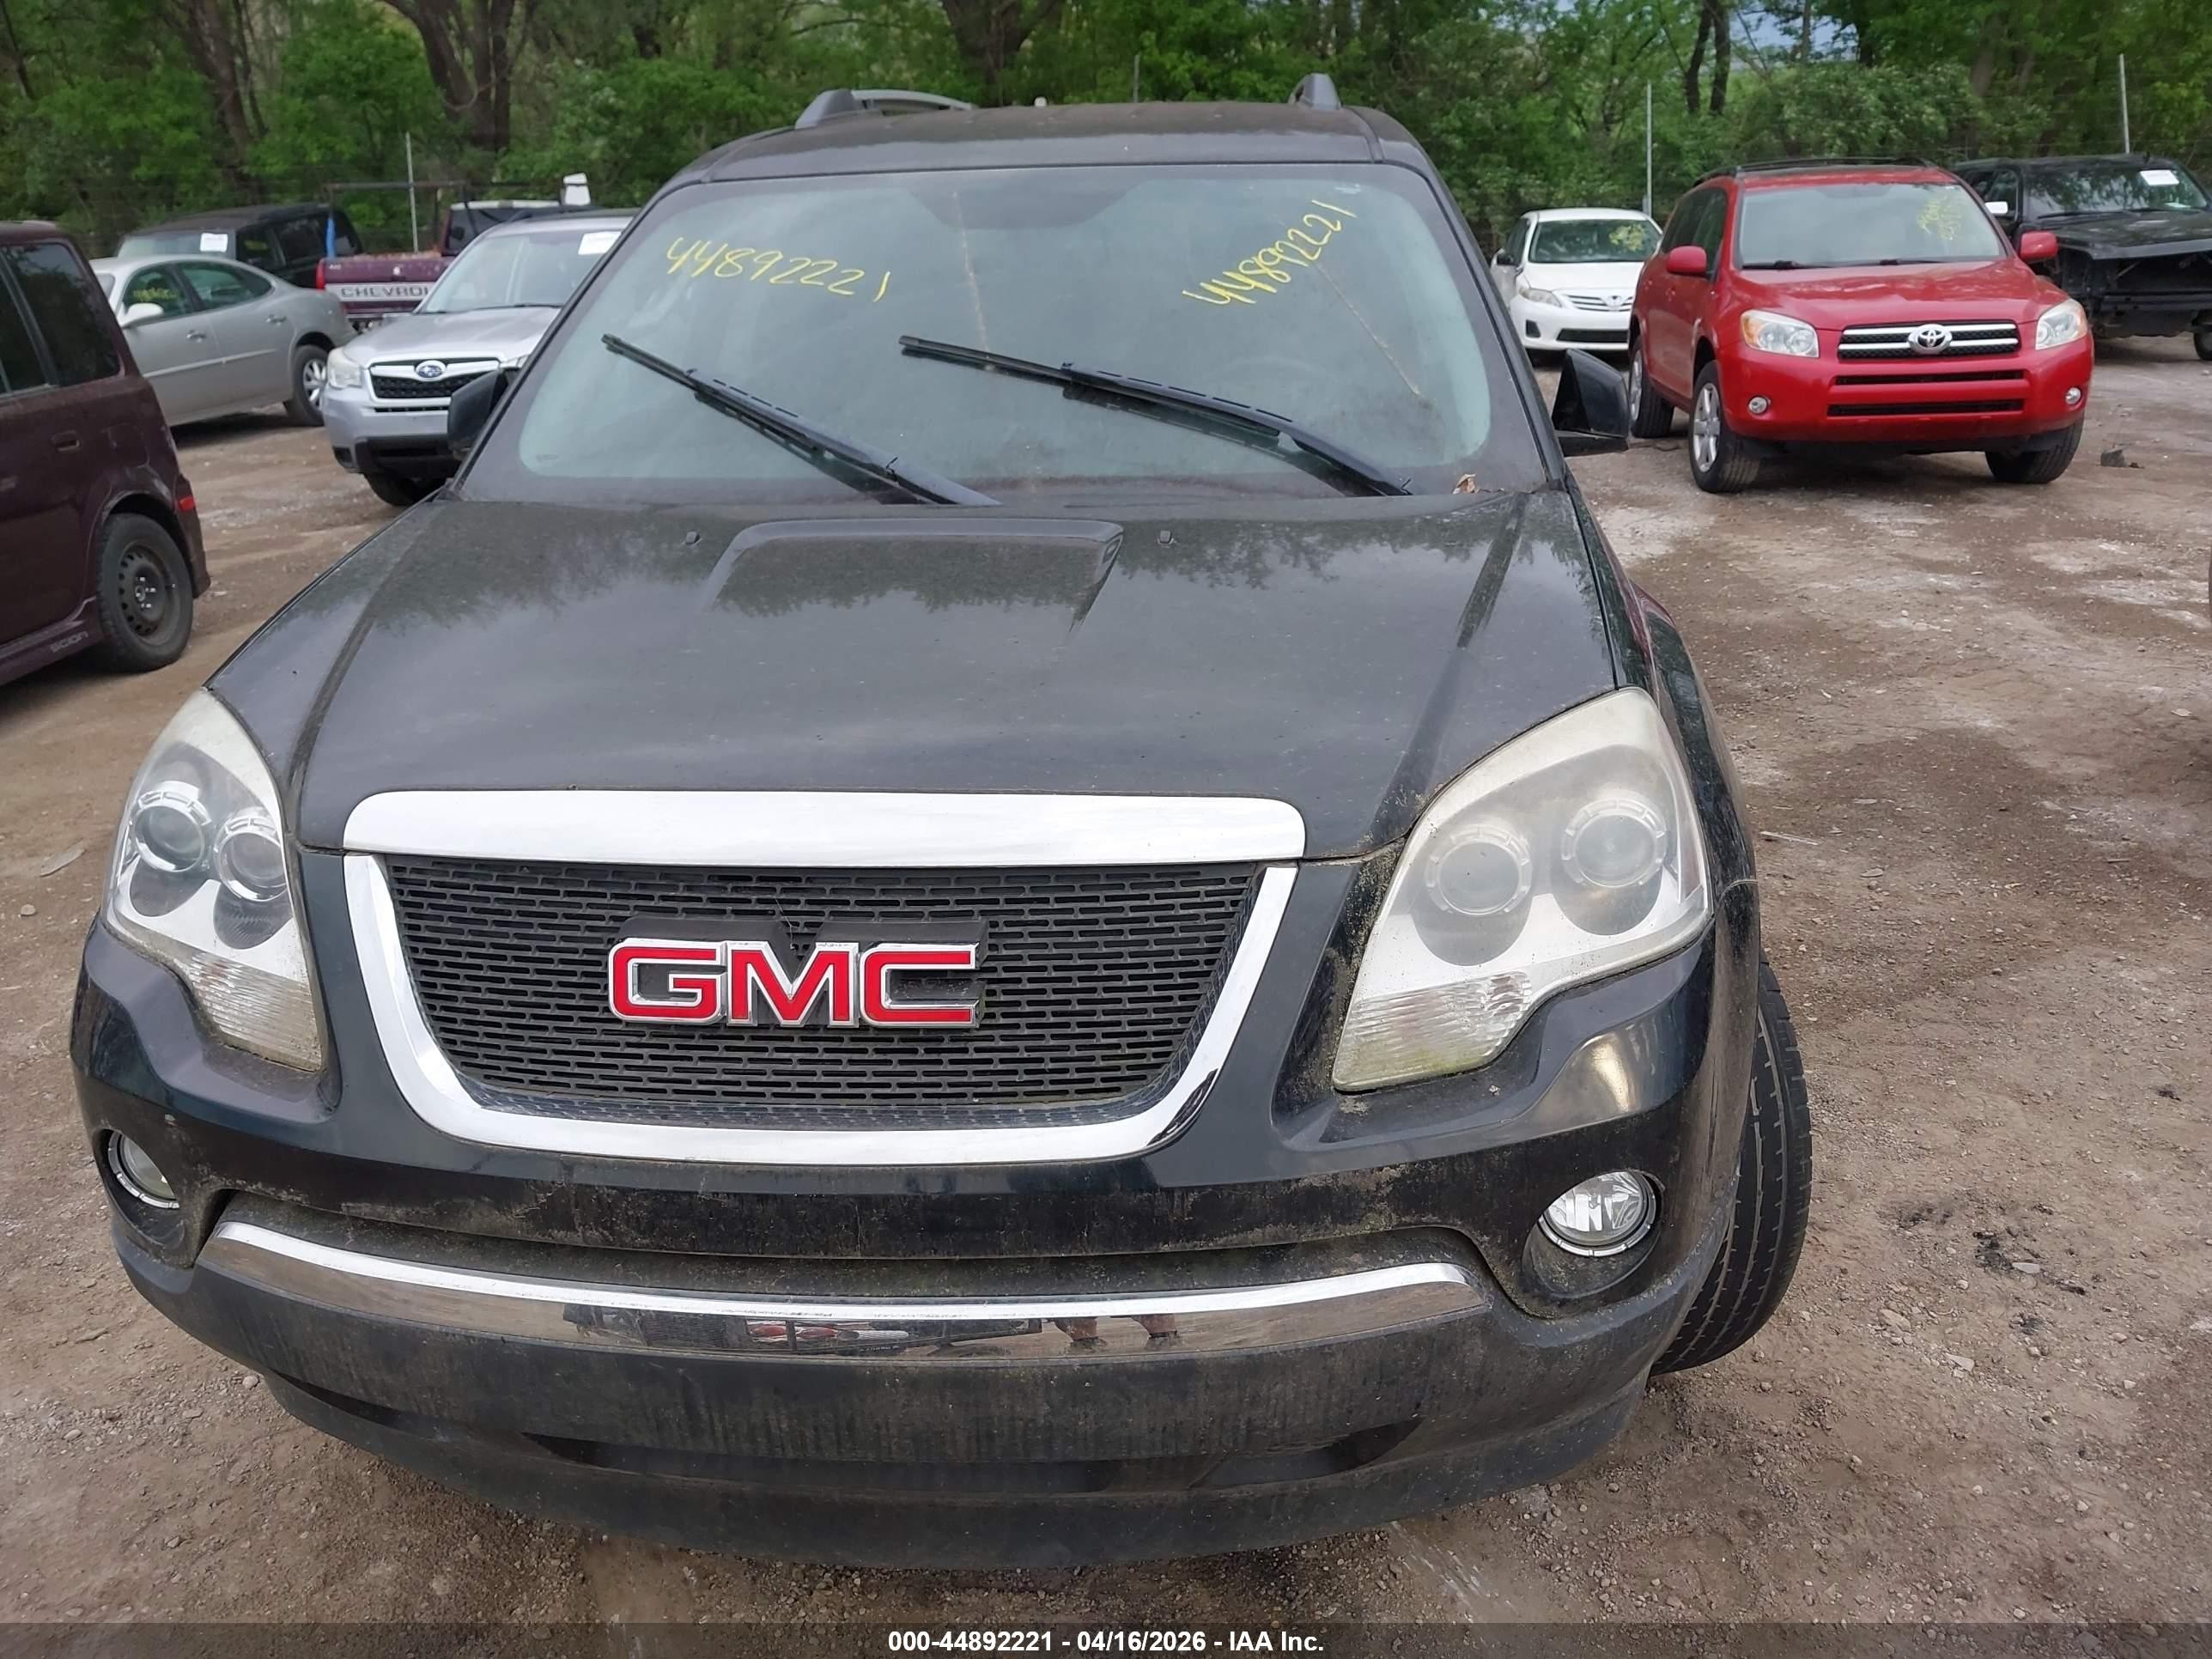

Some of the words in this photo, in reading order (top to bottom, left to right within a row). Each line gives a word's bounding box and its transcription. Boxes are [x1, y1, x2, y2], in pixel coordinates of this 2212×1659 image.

[666, 236, 891, 301] 44892221
[1182, 198, 1357, 305] 44892221
[608, 938, 980, 1027] GMC
